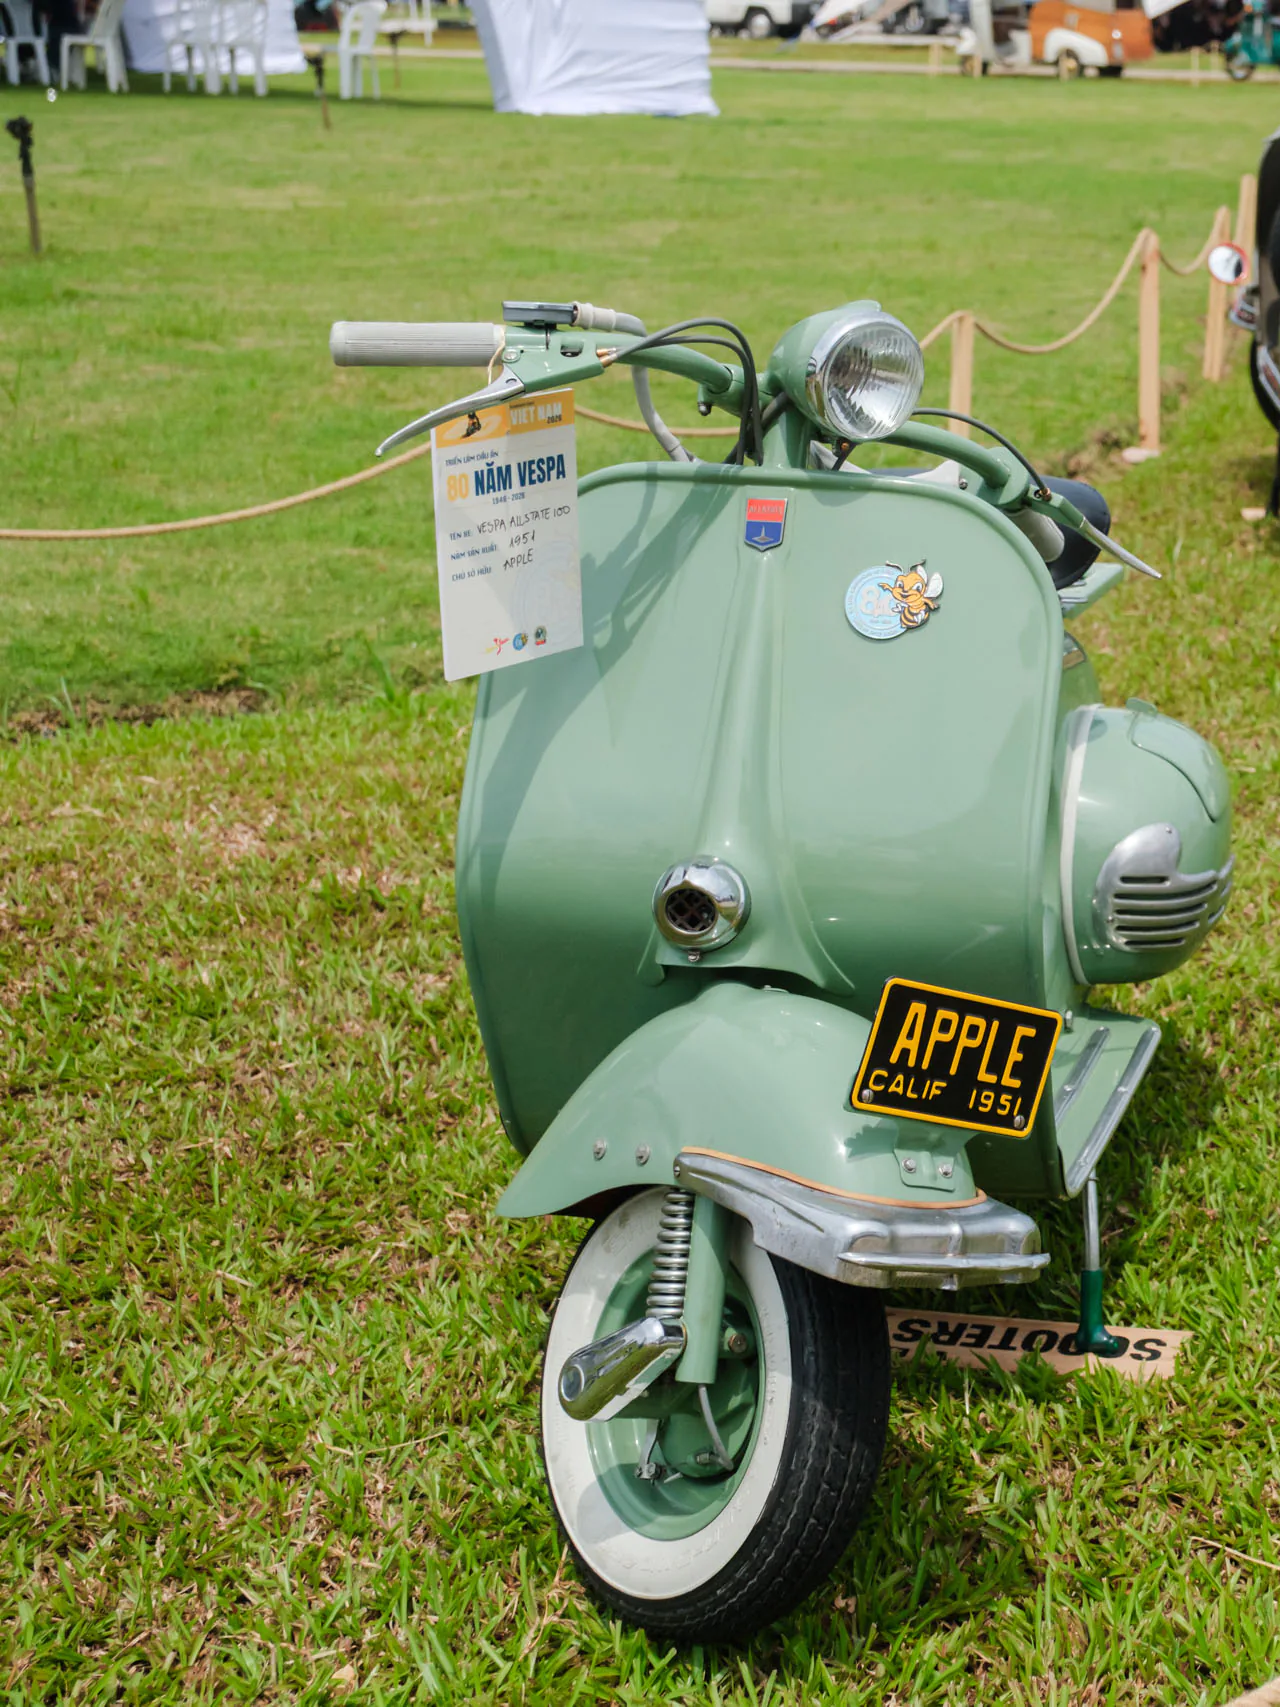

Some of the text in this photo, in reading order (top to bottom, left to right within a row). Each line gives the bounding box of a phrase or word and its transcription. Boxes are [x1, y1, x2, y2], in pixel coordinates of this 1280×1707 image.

[446, 454, 566, 502] 80 NĂM VESPA
[476, 505, 571, 534] VESPA ALLSTATE 100
[509, 529, 536, 548] 1951
[503, 548, 534, 571] APPLE
[889, 1002, 1037, 1089] APPLE
[868, 1069, 1022, 1117] CALIF 1951
